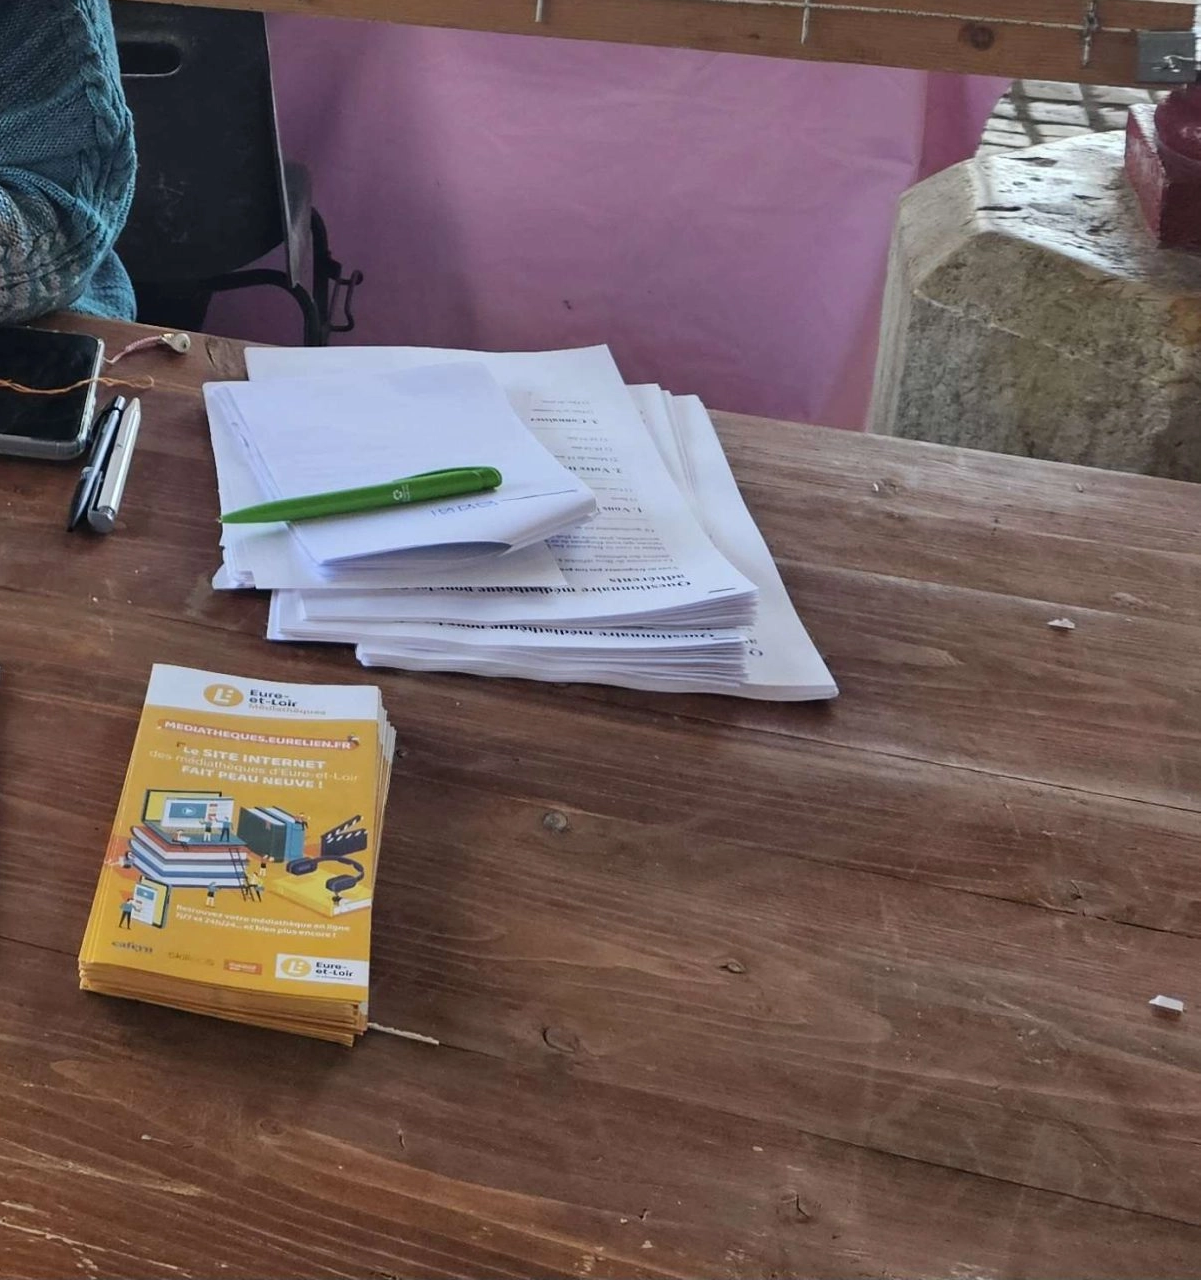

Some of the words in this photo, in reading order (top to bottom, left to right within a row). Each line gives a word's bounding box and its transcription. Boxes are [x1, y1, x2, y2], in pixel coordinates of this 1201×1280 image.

[580, 580, 692, 594] Questionnaire
[250, 689, 289, 699] Eure-
[249, 697, 297, 707] et-Loir
[183, 746, 199, 756] Le
[203, 748, 238, 762] SITE
[243, 754, 325, 769] INTERNET
[182, 765, 214, 777] FAIT
[219, 770, 258, 784] PEAU
[263, 774, 315, 789] NEUVE
[316, 968, 353, 978] et-Loir
